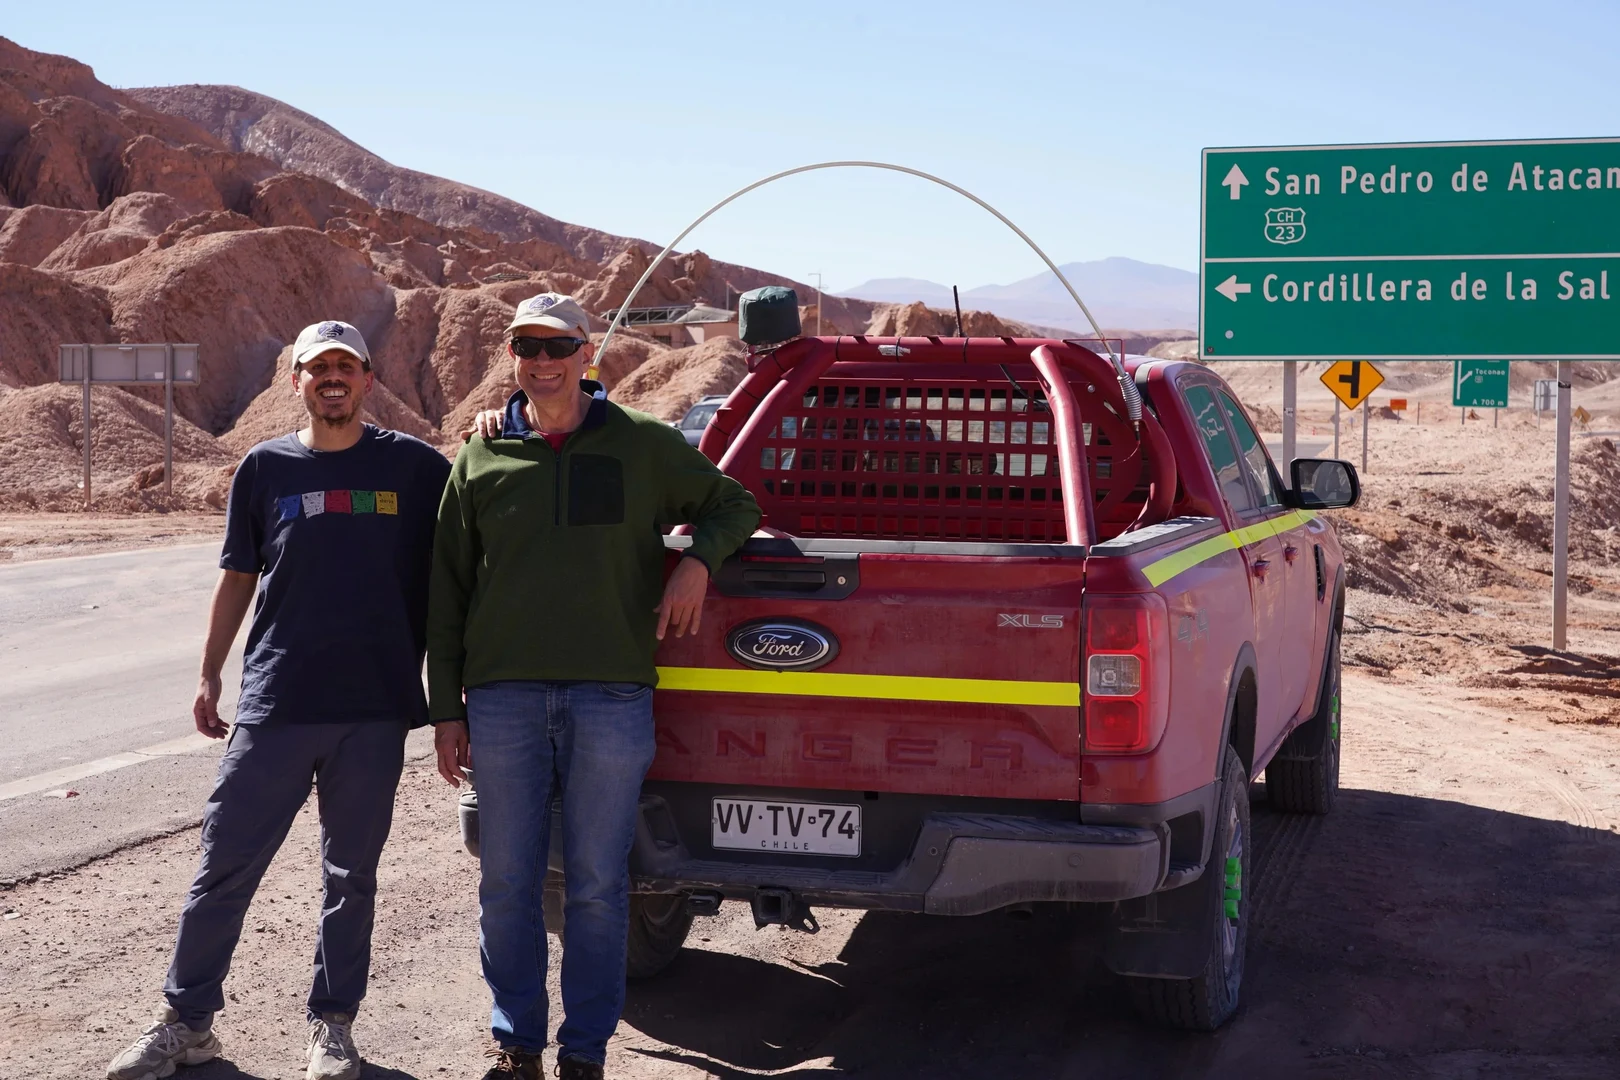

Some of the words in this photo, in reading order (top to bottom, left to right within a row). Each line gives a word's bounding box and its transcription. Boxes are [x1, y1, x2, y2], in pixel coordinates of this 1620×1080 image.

[1264, 167, 1320, 196] San
[1340, 165, 1433, 194] Pedro
[1451, 163, 1489, 192] de
[1276, 211, 1294, 223] CH
[1275, 226, 1295, 240] 23
[1263, 272, 1432, 302] Cordillera
[1450, 271, 1487, 301] de
[1506, 271, 1537, 301] la
[1557, 270, 1611, 301] Sal
[1475, 368, 1506, 376] Toconao
[997, 613, 1064, 628] XLS
[752, 632, 805, 656] Ford
[655, 726, 1024, 771] ANGER
[760, 840, 809, 851] CHILE
